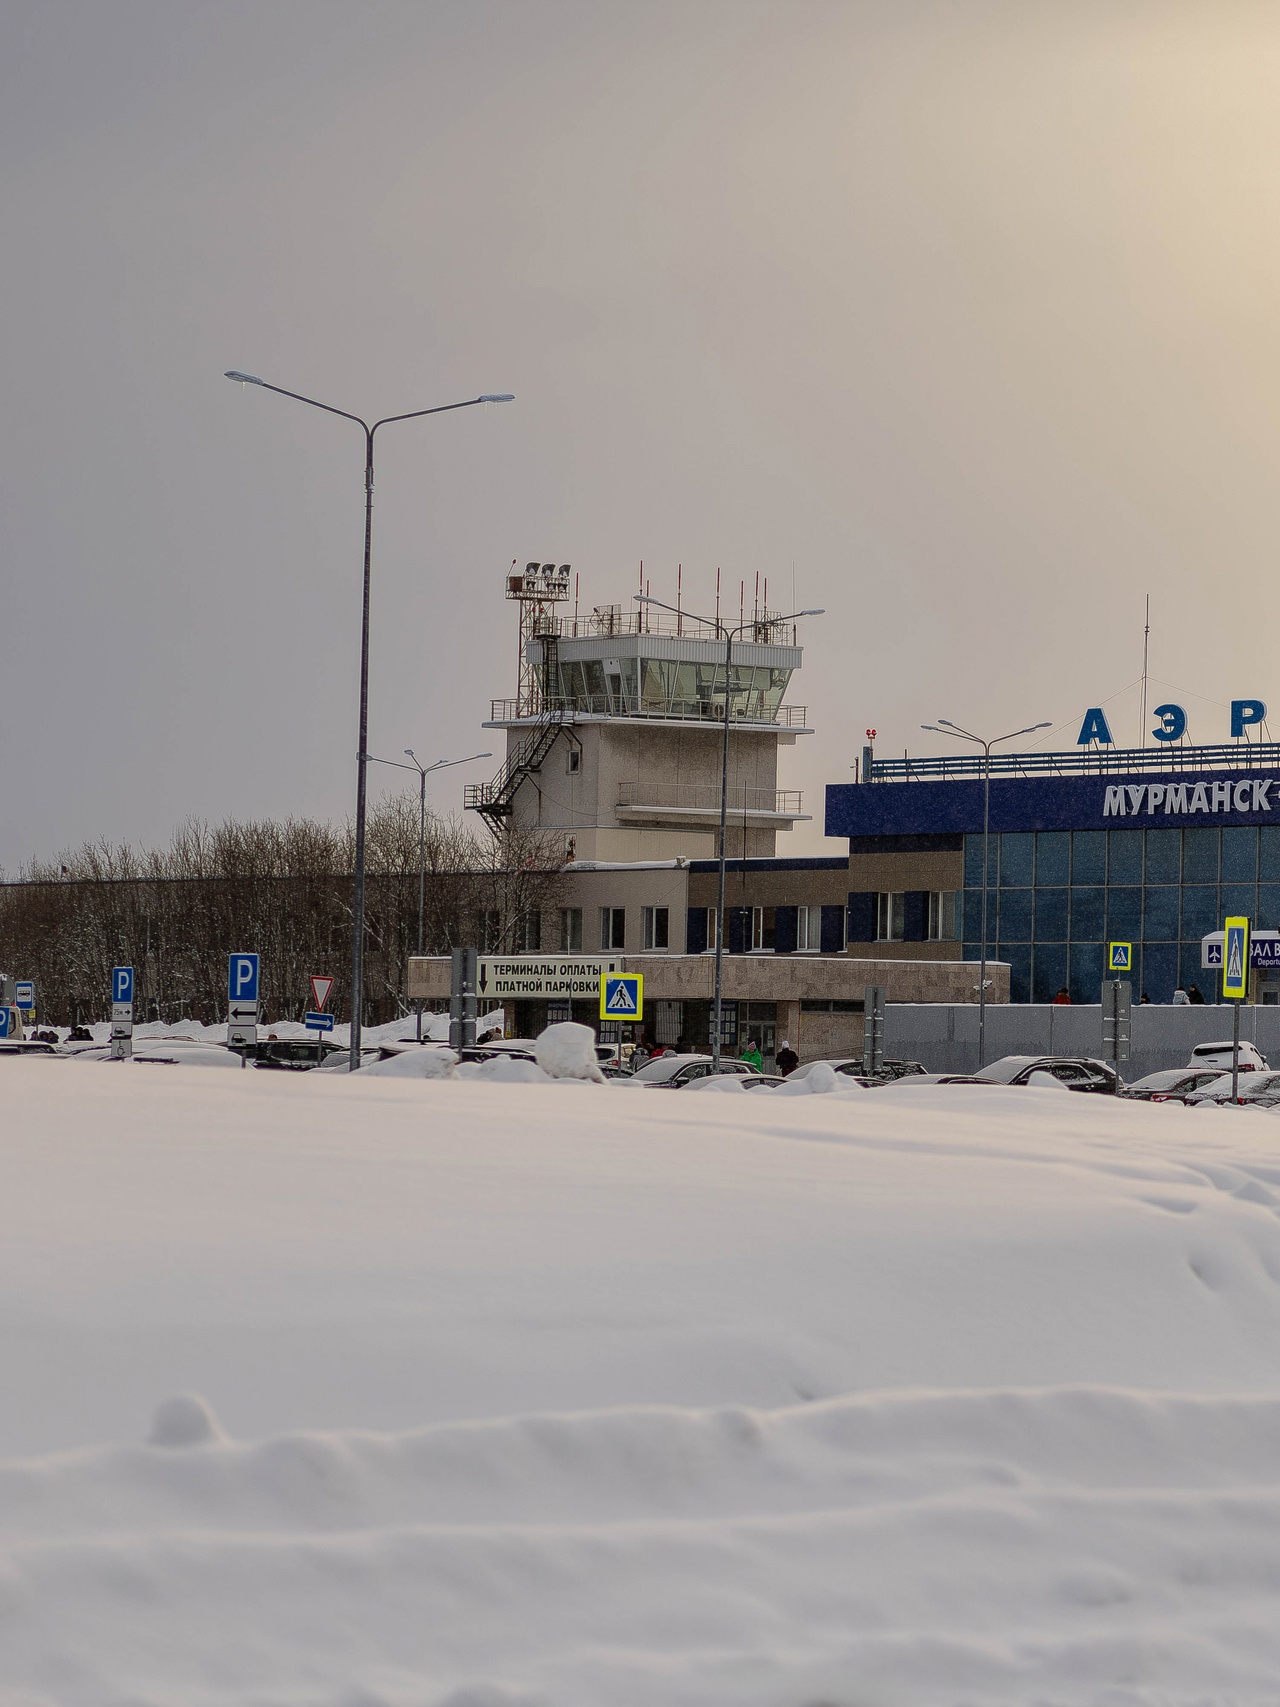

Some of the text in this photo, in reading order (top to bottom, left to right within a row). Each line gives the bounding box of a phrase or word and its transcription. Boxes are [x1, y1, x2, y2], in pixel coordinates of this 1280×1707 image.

[1103, 779, 1274, 817] МУРМАНСК
[236, 960, 253, 996] P
[493, 964, 602, 976] ТЕРМИНАЛЫ ОПЛАТЫ
[117, 971, 130, 999] P
[495, 978, 600, 992] ПЛАТНОЙ ПАРКОВКИ
